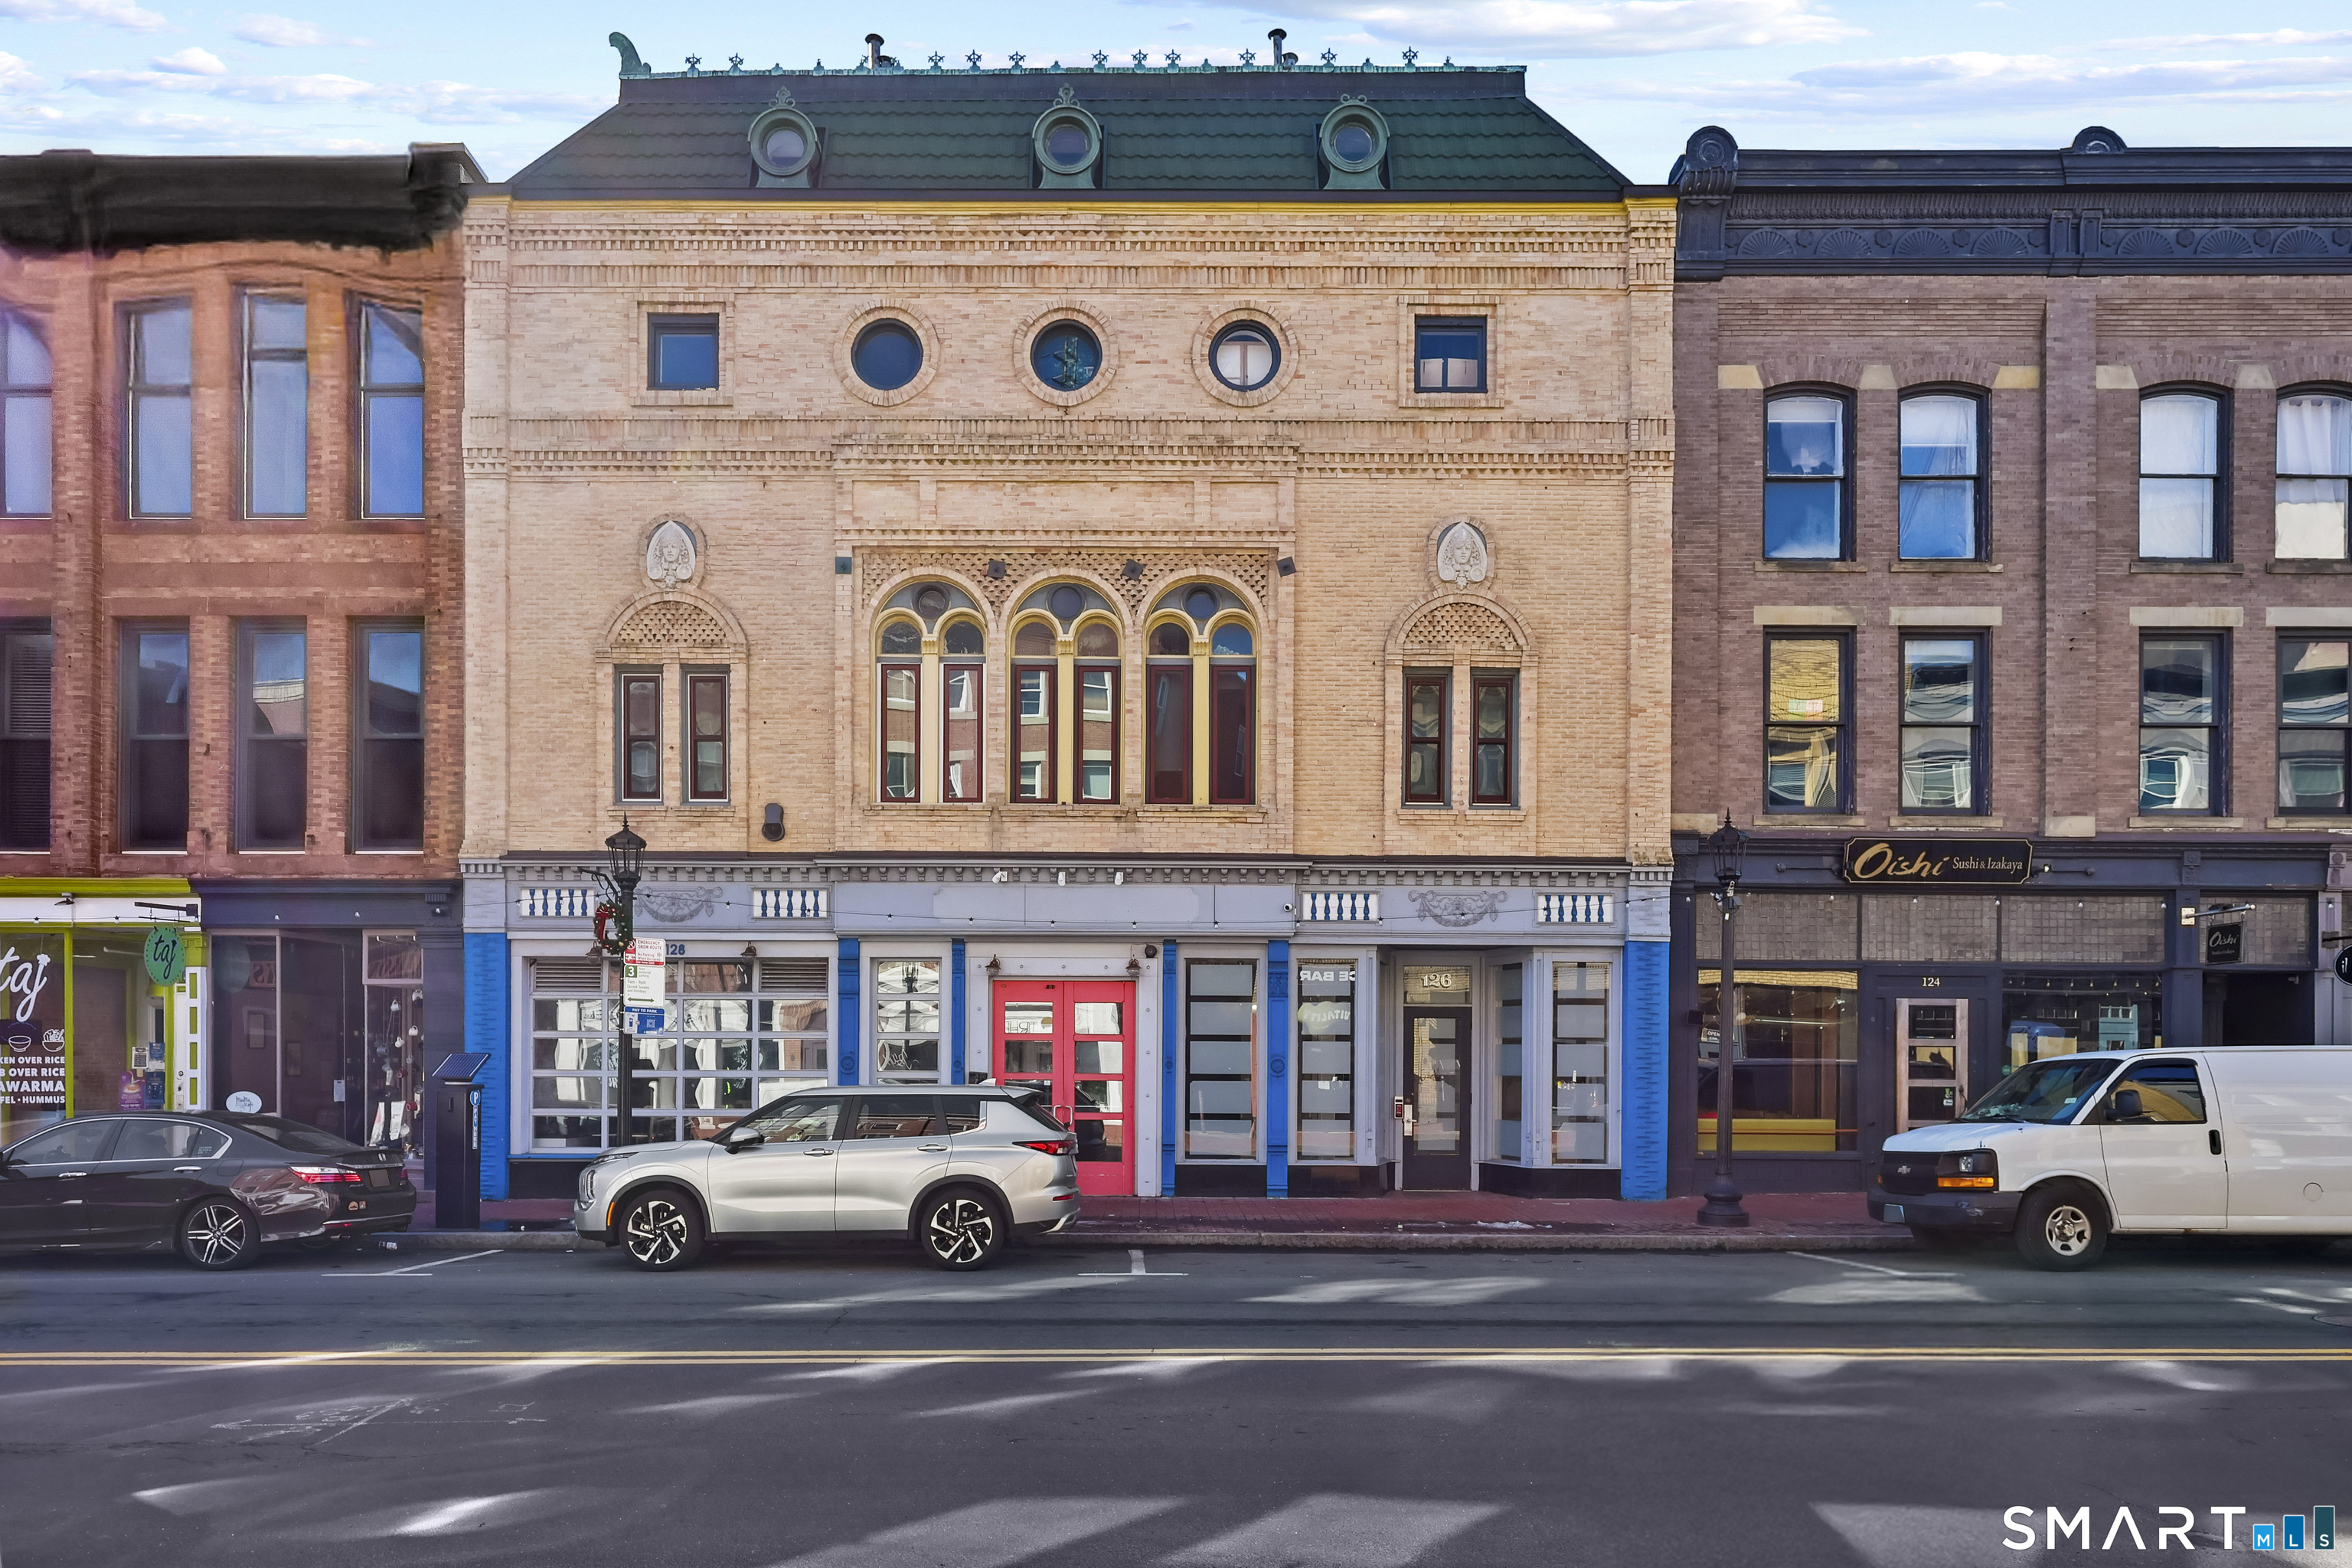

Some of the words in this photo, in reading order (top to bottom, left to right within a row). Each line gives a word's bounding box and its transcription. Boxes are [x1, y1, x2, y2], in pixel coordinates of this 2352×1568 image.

[1854, 843, 1950, 878] Oishi
[1953, 857, 1978, 870] Sushi
[1987, 857, 2023, 874] Izakaya
[2210, 932, 2239, 947] Oishi
[666, 944, 685, 956] 128
[153, 935, 177, 979] taj
[628, 966, 635, 977] 3
[1423, 973, 1452, 988] 126
[1922, 977, 1940, 987] 124
[8, 1068, 38, 1077] OVER
[41, 1068, 65, 1076] RICE
[22, 1096, 65, 1104] HUMMUS
